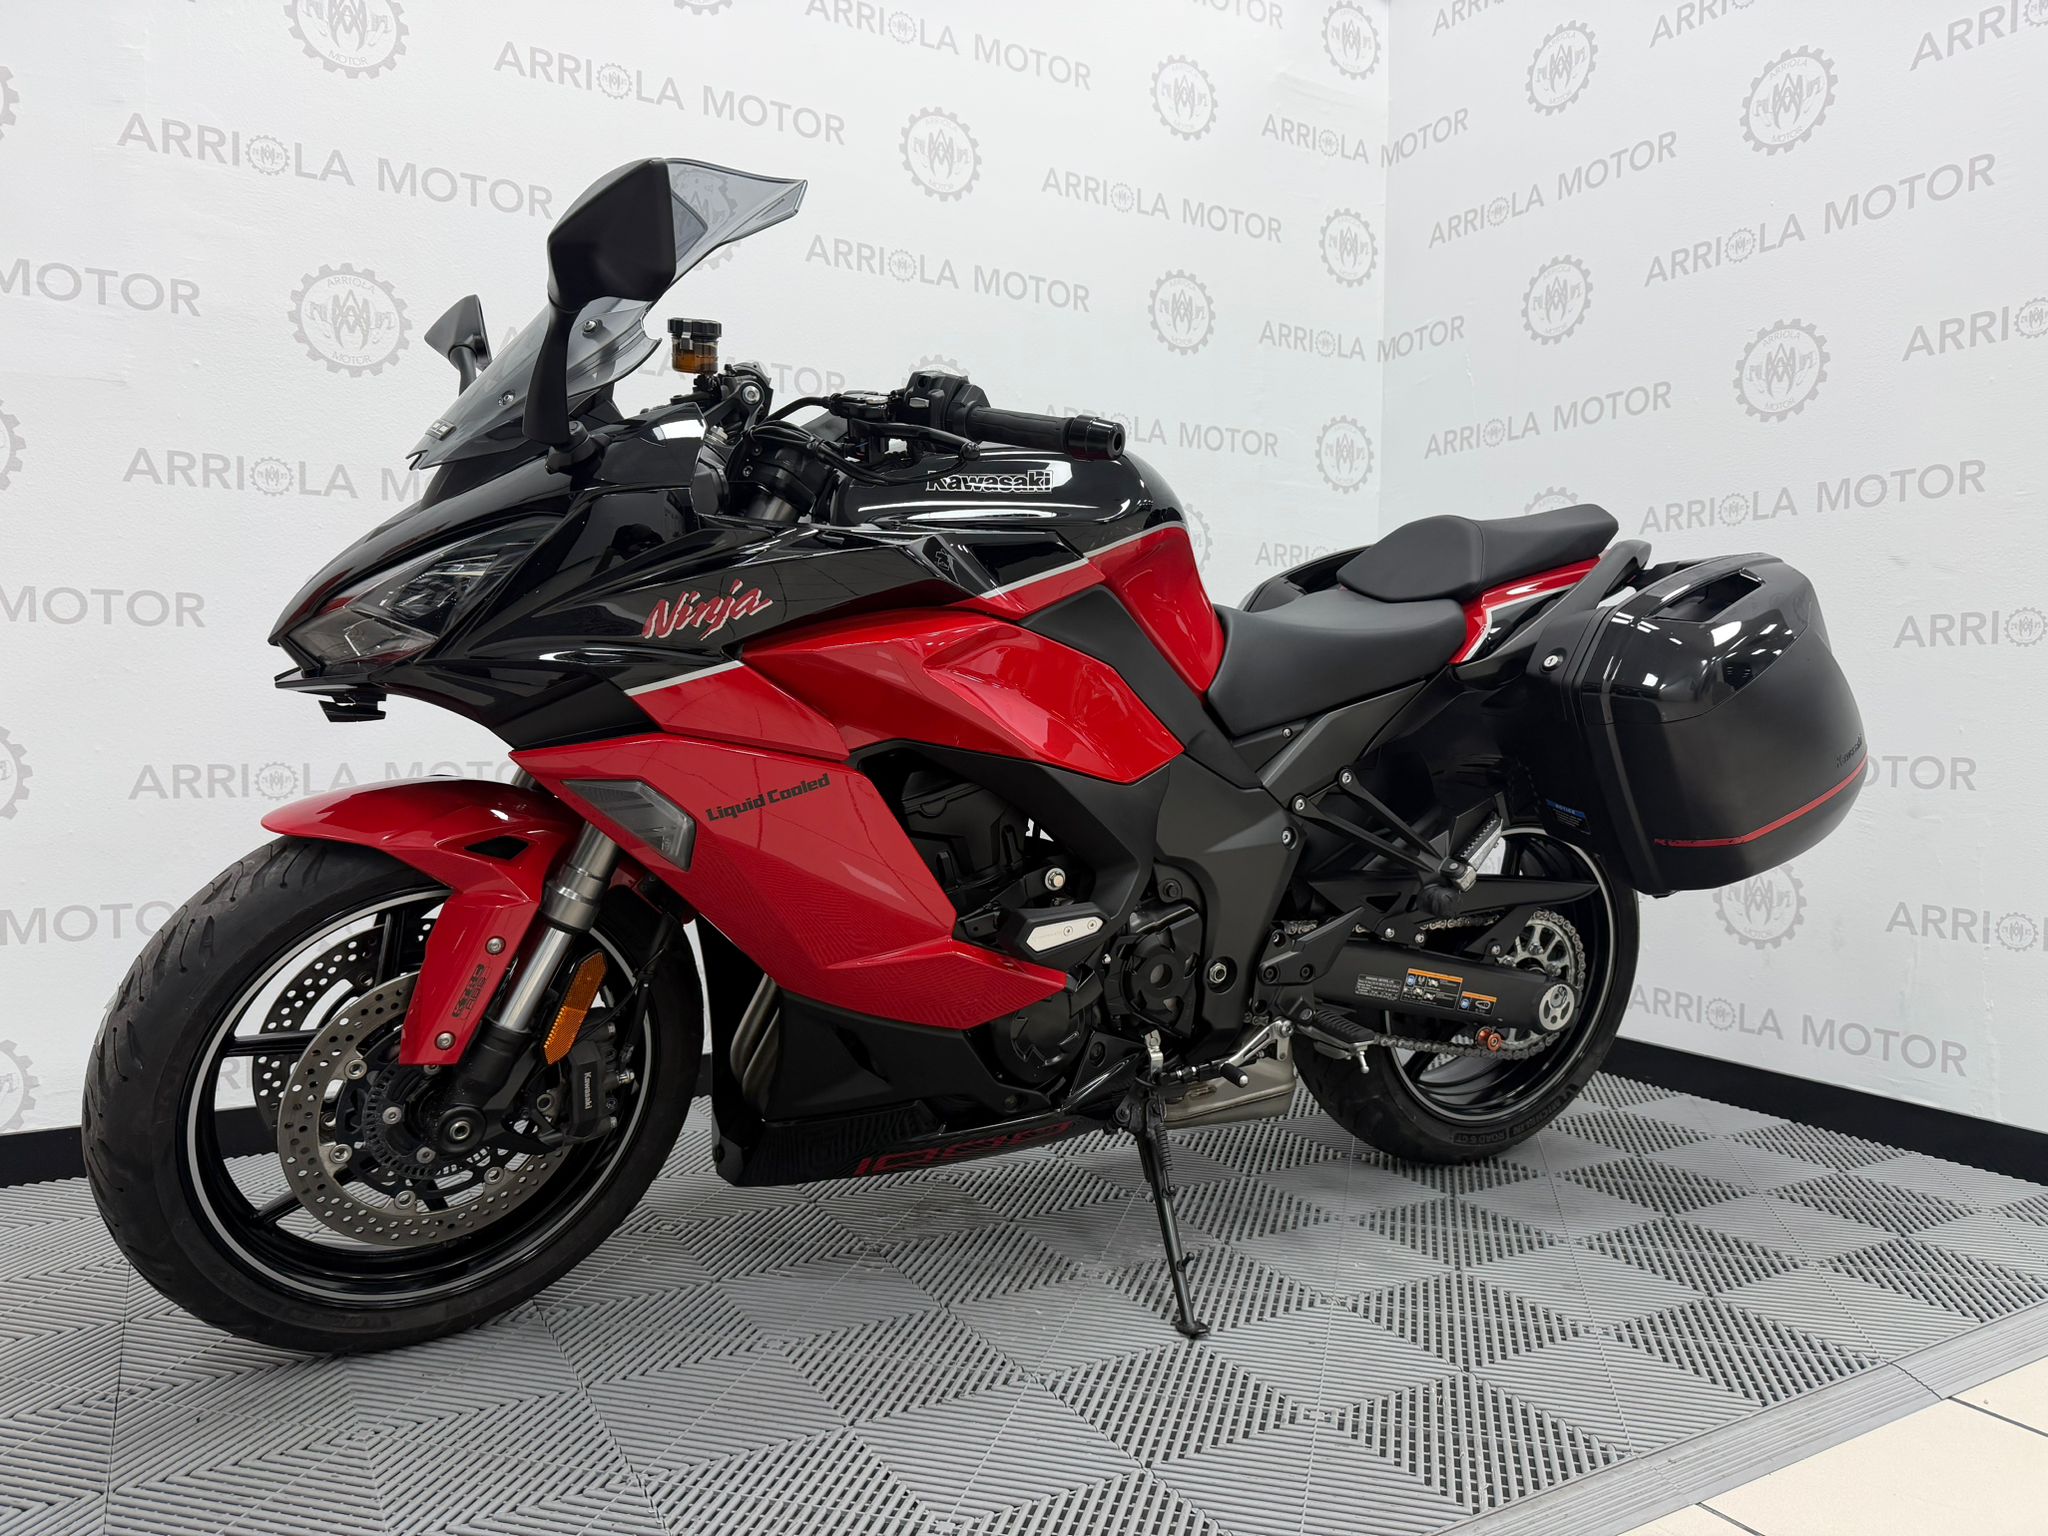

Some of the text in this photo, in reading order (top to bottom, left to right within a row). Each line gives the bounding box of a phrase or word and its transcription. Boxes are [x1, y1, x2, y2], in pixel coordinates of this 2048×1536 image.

[328, 50, 369, 66] MOTOR
[804, 0, 1091, 91] ARRIOLA MOTOR
[494, 41, 845, 145] ARRIOLA MOTOR
[117, 112, 553, 219] ARRIOLA MOTOR
[1262, 107, 1469, 168] ARRIOLA MOTOR
[1042, 167, 1282, 244] ARRIOLA MOTOR
[1429, 130, 1677, 249] ARRIOLA MOTOR
[1645, 153, 1996, 287] ARRIOLA MOTOR
[0, 258, 201, 317] MOTOR
[327, 275, 376, 295] ARRIOLA
[805, 234, 1090, 313] ARRIOLA MOTOR
[331, 350, 372, 365] MOTOR
[1259, 315, 1465, 363] ARRIOLA MOTOR
[1179, 422, 1278, 458] MOTOR
[1424, 382, 1672, 460] ARRIOLA MOTOR
[123, 447, 359, 500] ARRIOLA
[1639, 459, 1986, 535] ARRIOLA MOTOR
[0, 585, 206, 628] MOTOR
[642, 579, 773, 641] Ninja
[127, 760, 358, 801] ARRIOLA
[705, 773, 830, 822] Liquid Cooled
[0, 901, 177, 946] MOTO
[1631, 984, 1967, 1078] ARRIOLA MOTOR
[584, 1071, 593, 1110] Kawasaki
